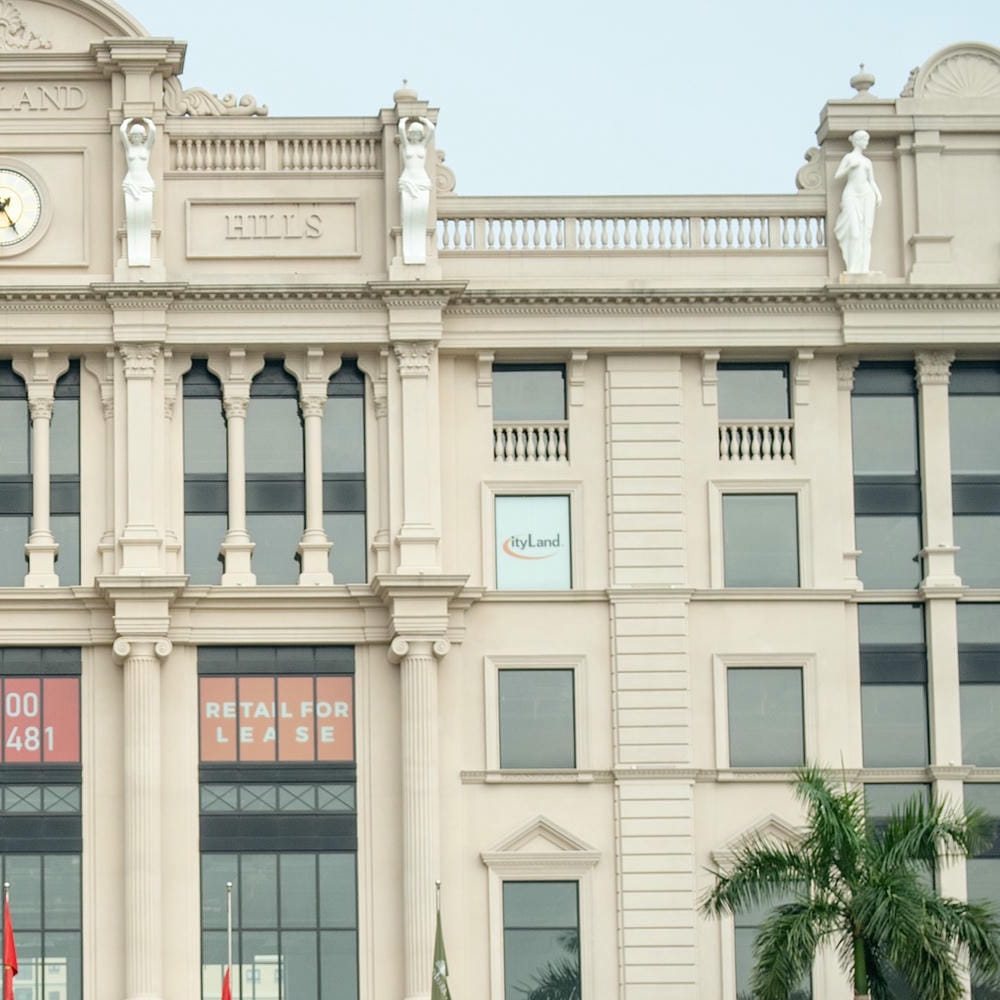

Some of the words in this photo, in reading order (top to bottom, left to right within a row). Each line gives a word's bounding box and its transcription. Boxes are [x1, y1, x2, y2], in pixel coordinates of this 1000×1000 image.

[224, 214, 323, 239] HILLS
[206, 702, 294, 718] RETAIL
[301, 702, 349, 718] FOR
[217, 726, 335, 743] LEASE
